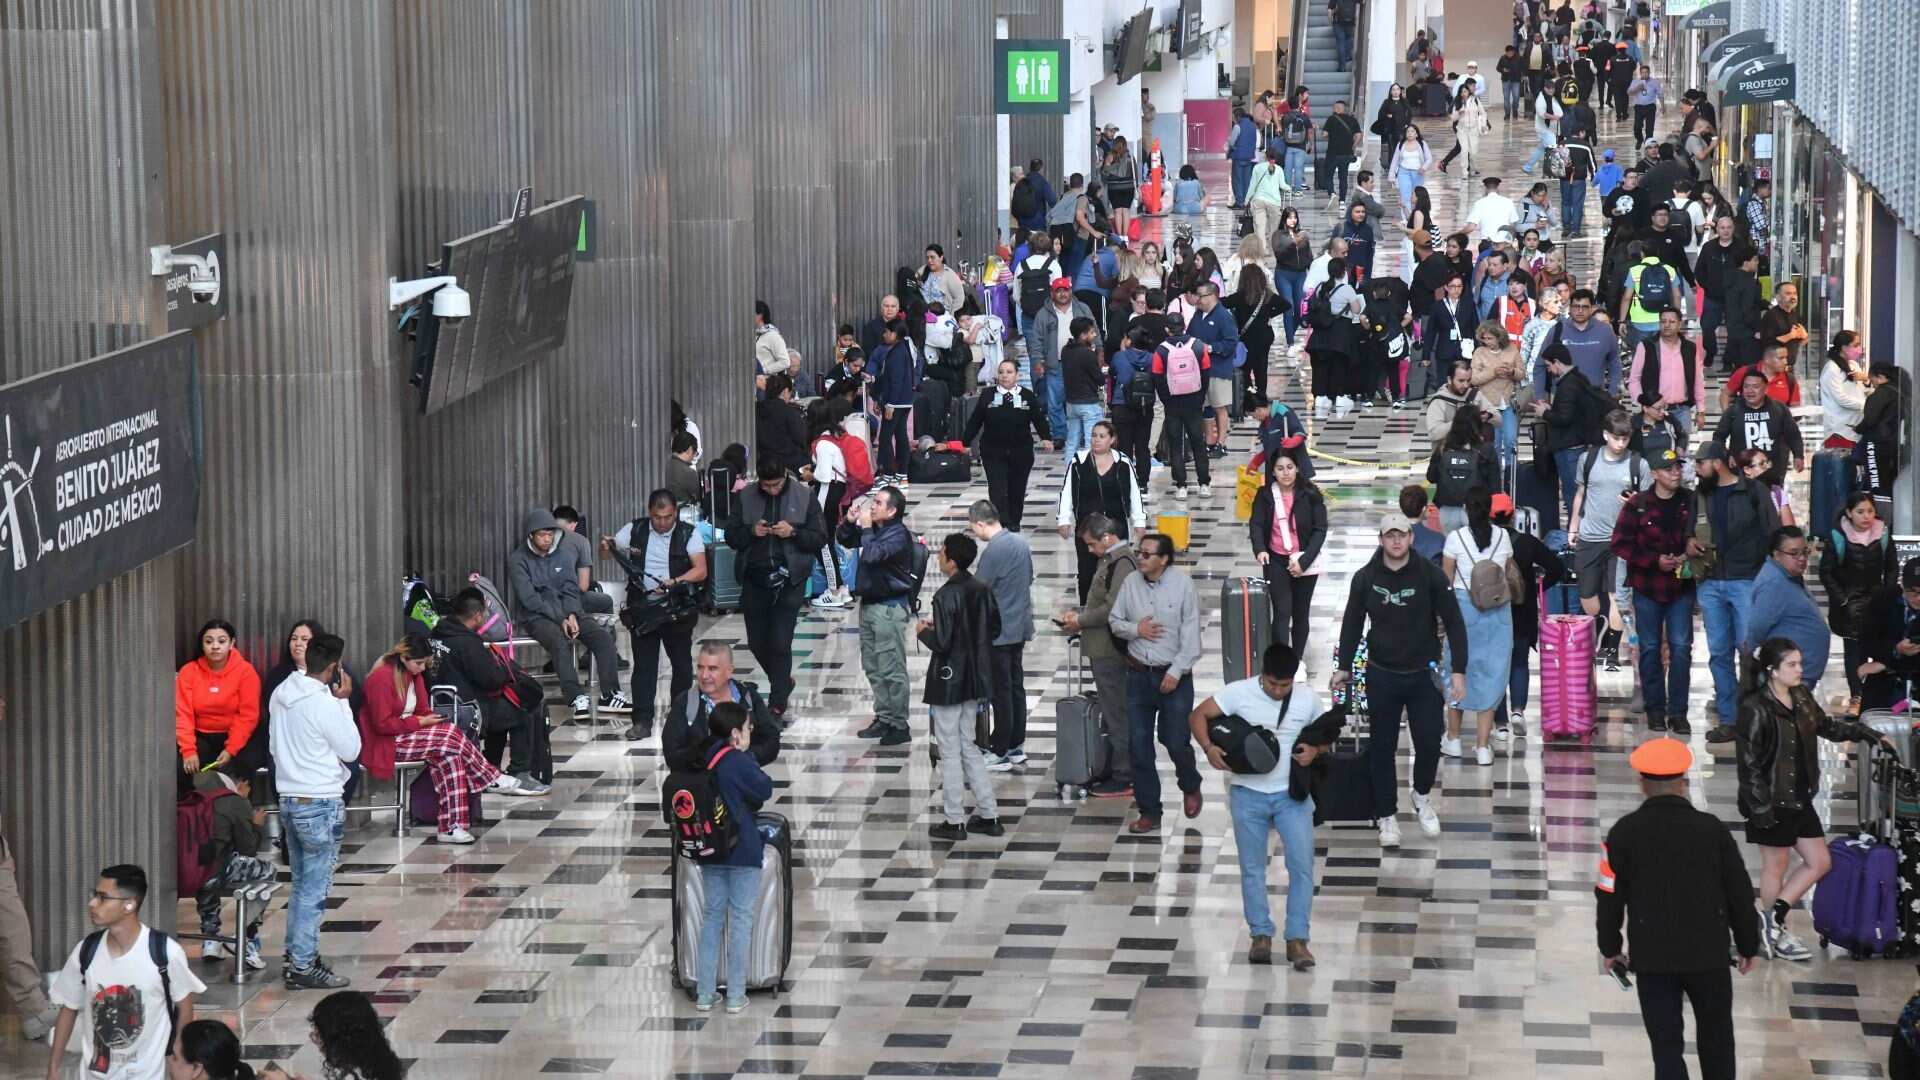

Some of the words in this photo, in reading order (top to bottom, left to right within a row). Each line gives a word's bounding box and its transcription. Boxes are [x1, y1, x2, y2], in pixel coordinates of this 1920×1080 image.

[1738, 77, 1789, 91] PROFECO
[55, 428, 105, 464] AEROPUERTO
[106, 408, 159, 445] INTERNACIONAL
[1744, 412, 1760, 421] FELIZ
[56, 459, 108, 511] BENITO
[111, 438, 161, 490] JUÁREZ
[57, 507, 103, 552] CIUDAD
[104, 503, 120, 533] DE
[121, 483, 162, 525] MÉXICO
